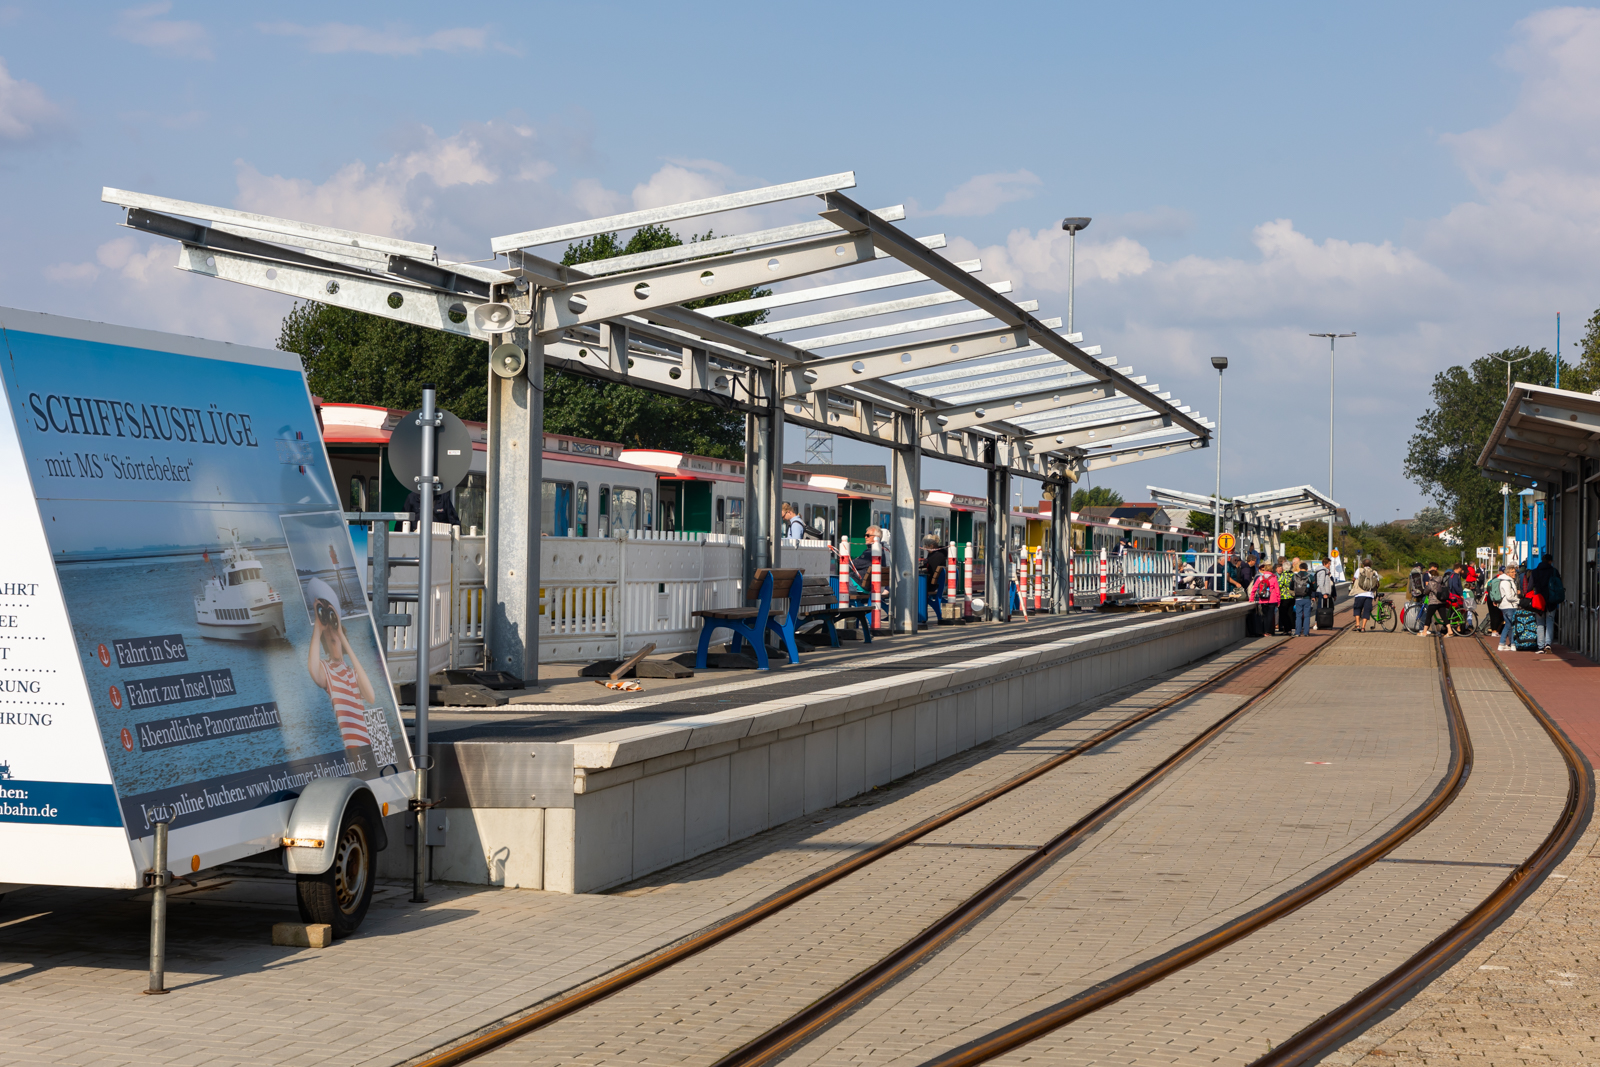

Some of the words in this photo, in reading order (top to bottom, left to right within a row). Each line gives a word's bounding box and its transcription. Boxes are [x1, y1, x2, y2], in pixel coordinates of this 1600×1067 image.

[28, 392, 259, 447] SCHIFFSAUSFLÜGE
[45, 451, 75, 478] mit
[74, 452, 104, 479] MS
[0, 582, 39, 596] HRT
[115, 643, 148, 665] Fahrt
[148, 640, 165, 661] in
[163, 639, 186, 659] See
[126, 683, 162, 706] Fahrt
[161, 685, 181, 701] zur
[180, 675, 209, 699] Insel
[208, 673, 234, 700] Juist
[140, 718, 204, 748] Abendliche
[202, 706, 281, 736] Panoramafahrt
[170, 792, 205, 817] online
[203, 784, 247, 809] buchen:
[245, 754, 368, 798] www.borkumer-kleinbahn.de
